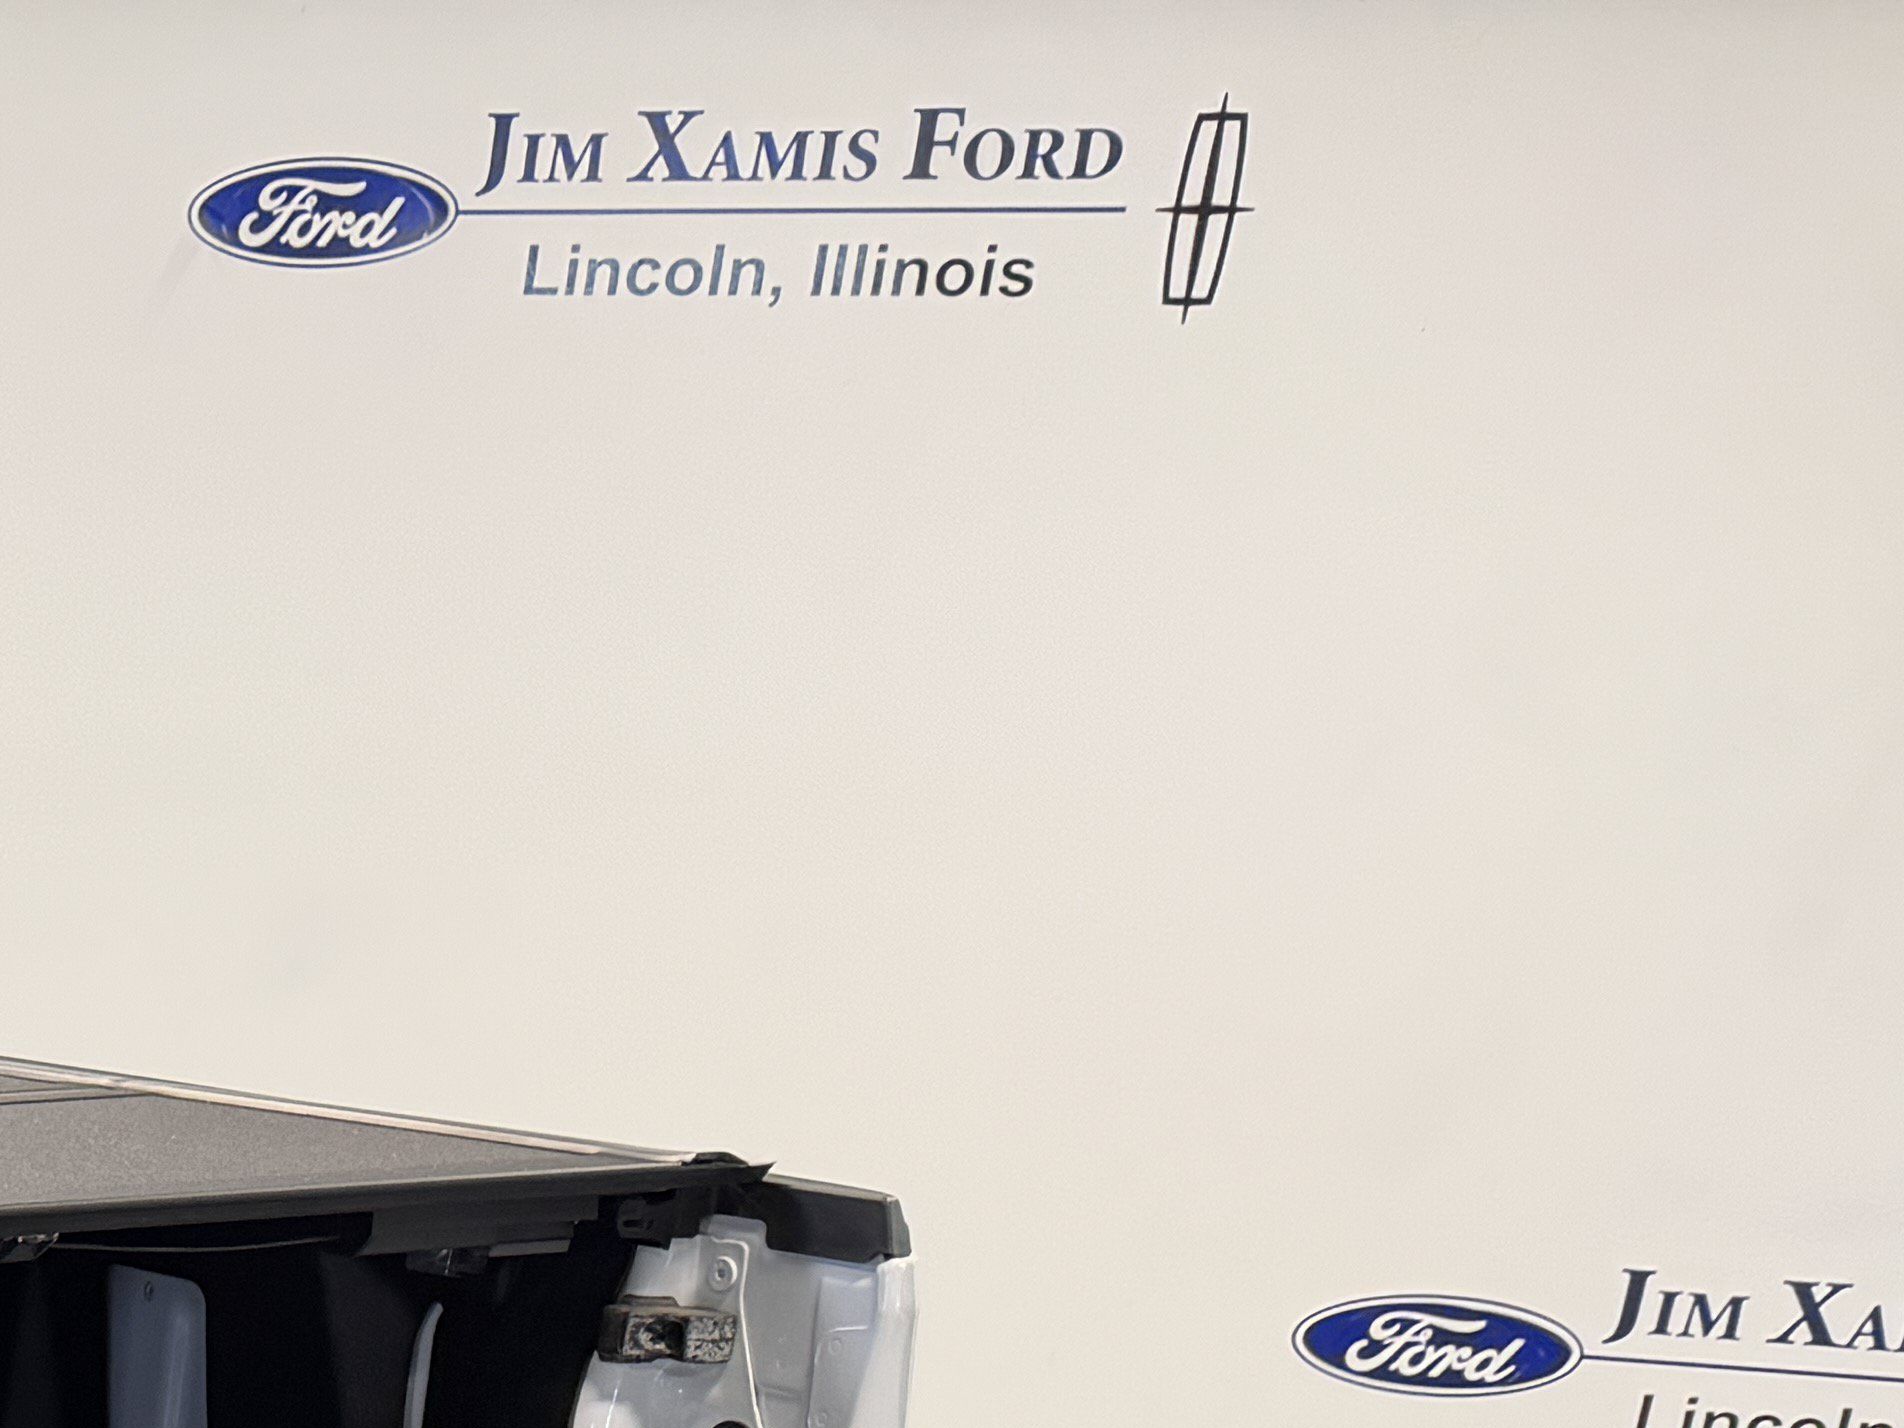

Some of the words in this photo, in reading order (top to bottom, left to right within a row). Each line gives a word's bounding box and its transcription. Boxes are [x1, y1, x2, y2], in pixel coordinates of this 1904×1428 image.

[474, 112, 608, 198] JIM
[626, 109, 879, 184] XAMIS
[902, 107, 1123, 181] FORD
[238, 177, 407, 249] Ford
[522, 243, 783, 308] Lincoln,
[809, 243, 1035, 298] Illinois
[1344, 1310, 1527, 1384] Ford
[1601, 1268, 1750, 1346] JIM
[1765, 1280, 1904, 1353] XA
